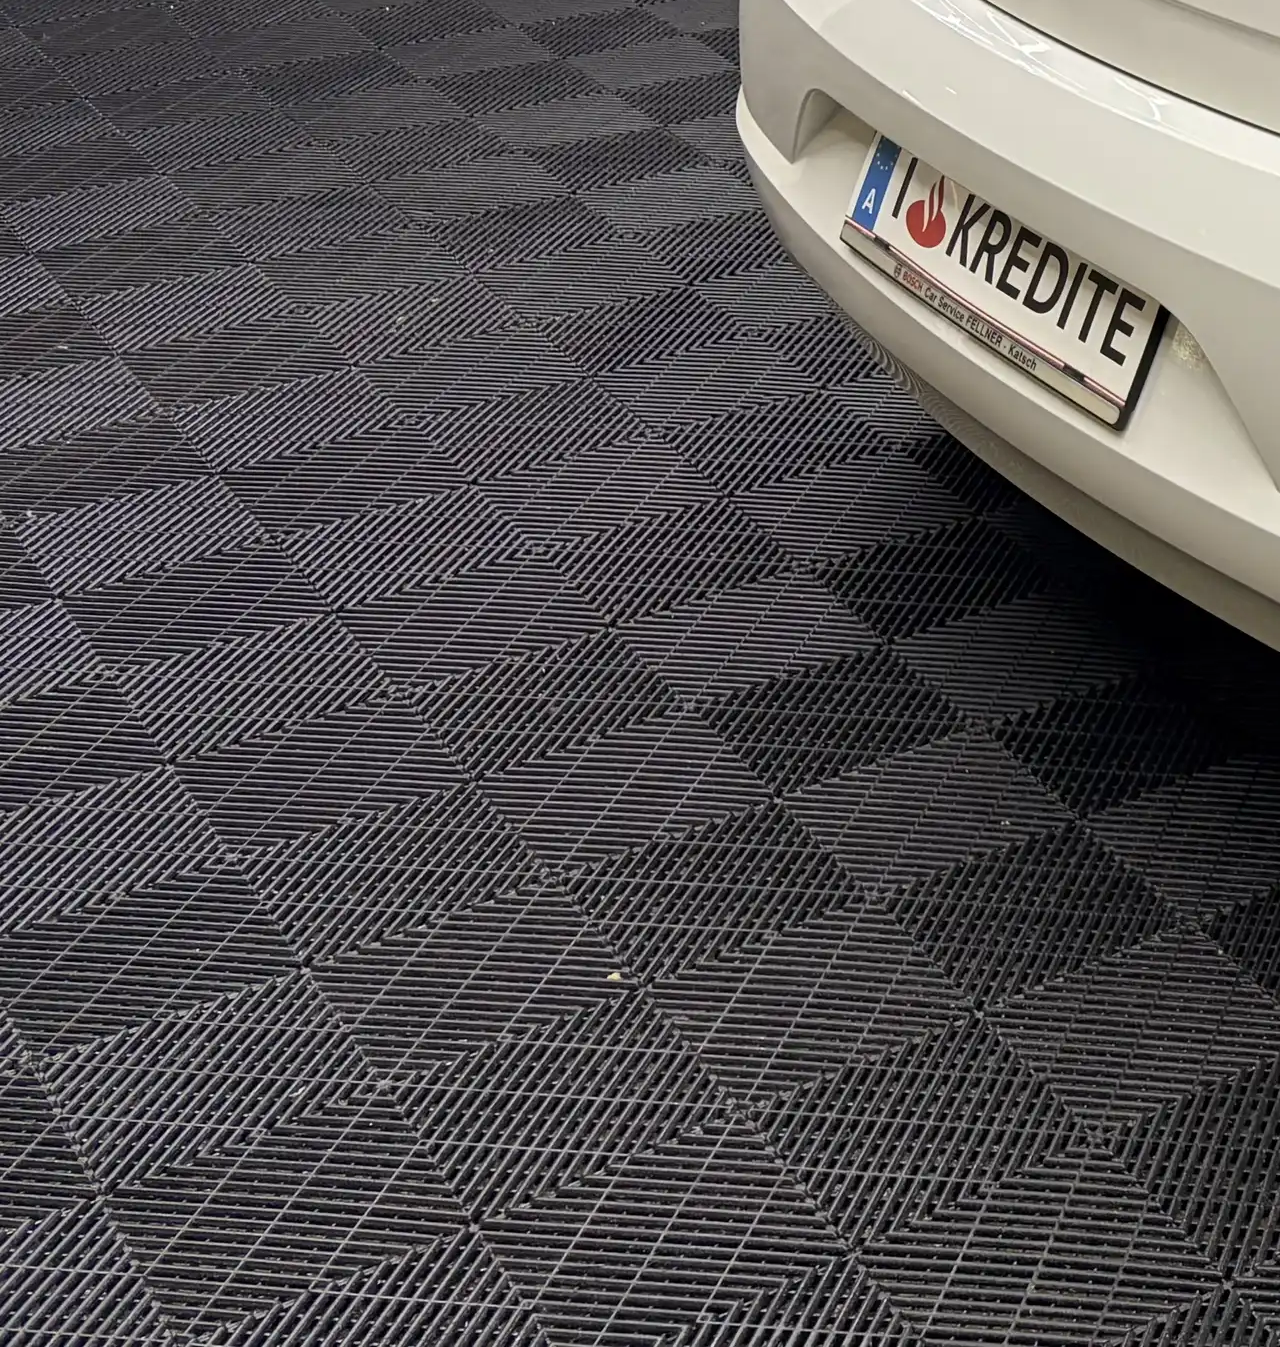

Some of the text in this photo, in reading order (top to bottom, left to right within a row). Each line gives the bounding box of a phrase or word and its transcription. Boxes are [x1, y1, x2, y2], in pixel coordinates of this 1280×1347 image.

[861, 188, 875, 215] A
[892, 156, 1147, 367] I KREDITE
[902, 270, 922, 293] BOSCH
[924, 287, 938, 303] Car
[938, 296, 965, 322] Service
[966, 315, 1003, 348] FELLNER
